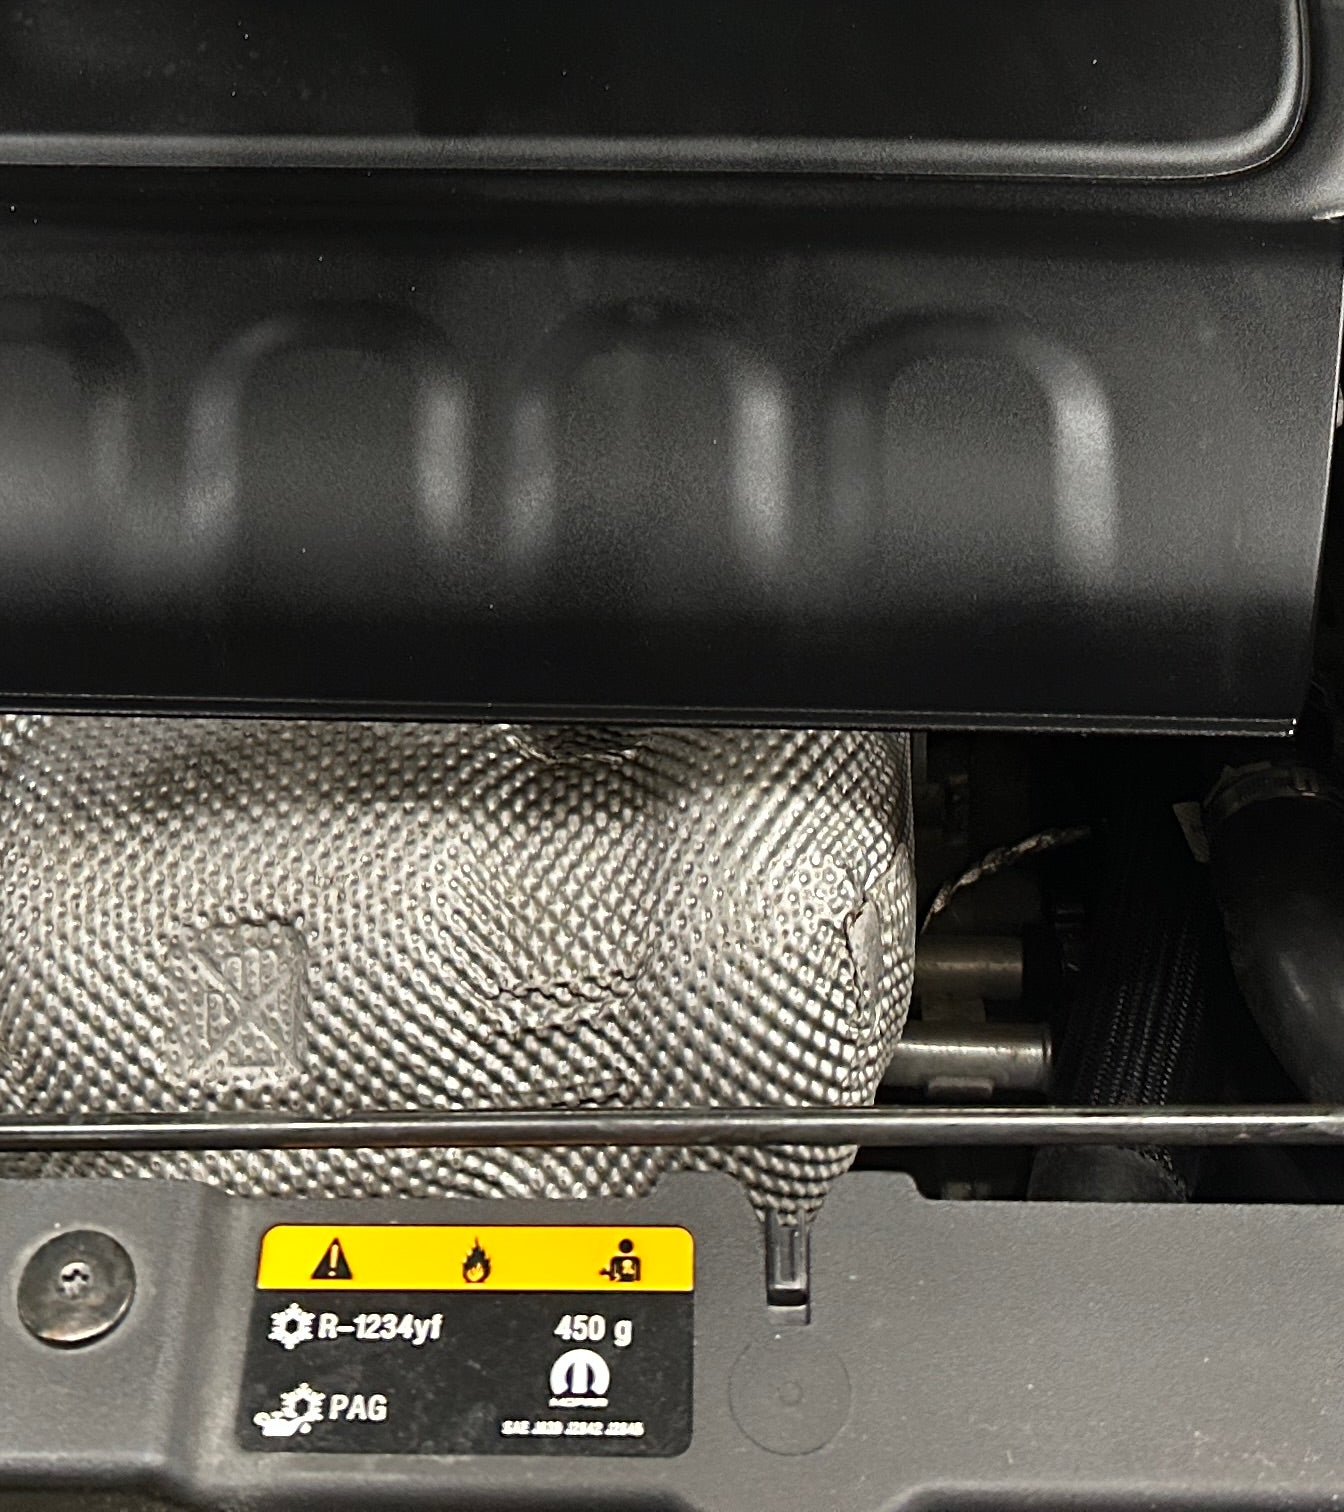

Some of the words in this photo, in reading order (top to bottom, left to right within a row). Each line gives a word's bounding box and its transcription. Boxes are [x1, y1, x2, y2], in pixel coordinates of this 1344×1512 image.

[317, 1312, 443, 1346] R-1234yf
[554, 1314, 606, 1341] 450
[614, 1318, 633, 1346] g
[328, 1393, 388, 1422] PAG
